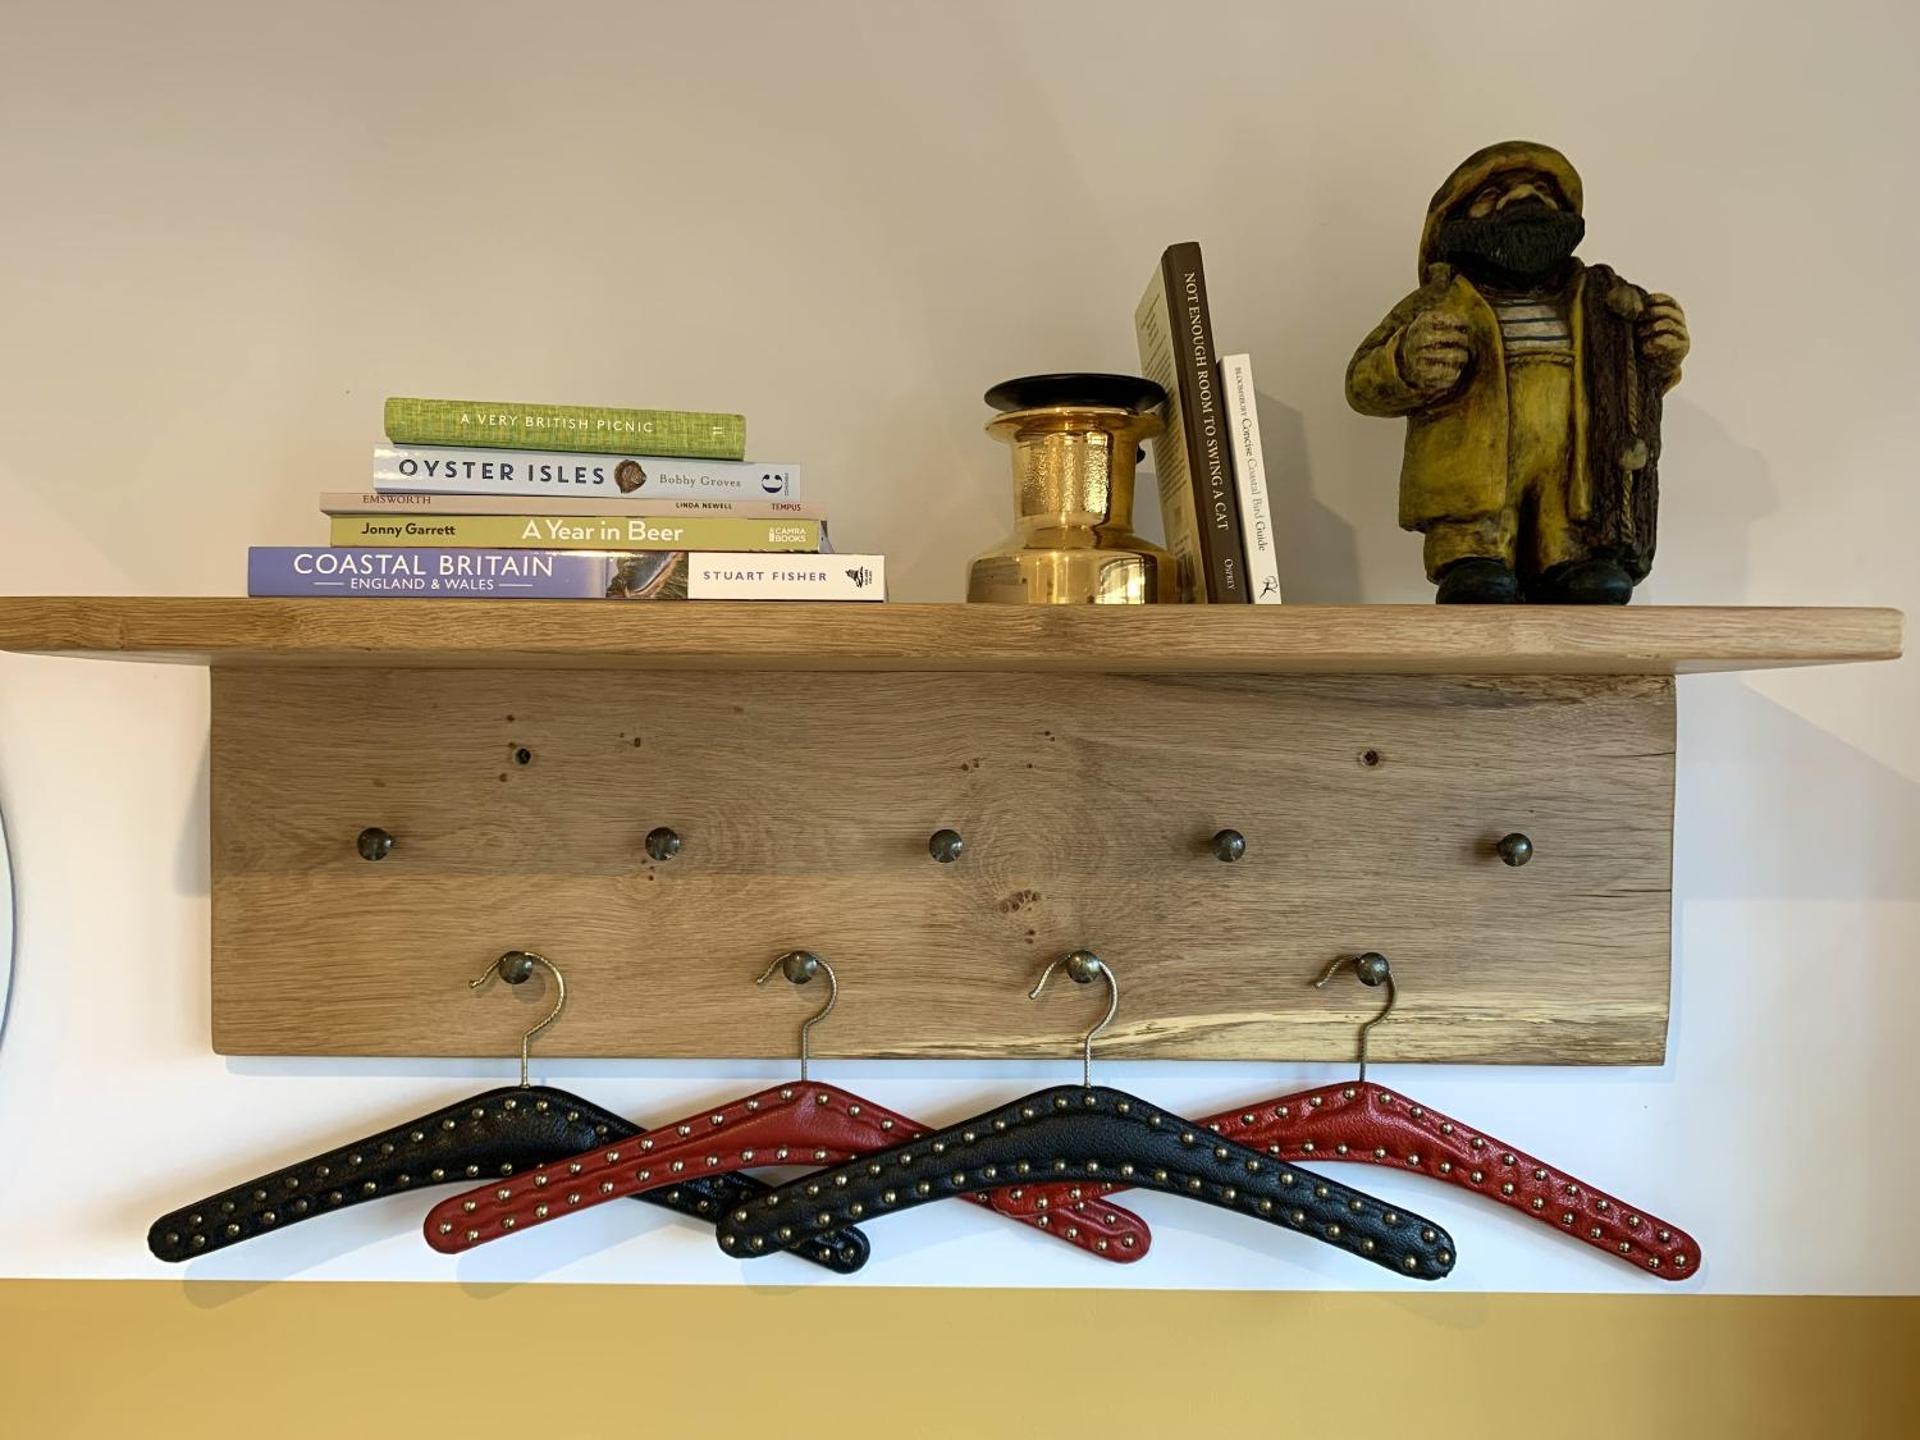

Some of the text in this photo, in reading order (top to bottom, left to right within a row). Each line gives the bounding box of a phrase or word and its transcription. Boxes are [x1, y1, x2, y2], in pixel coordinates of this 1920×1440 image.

[1184, 271, 1229, 531] NOT ENOUGH ROOM TO SWING A CAT
[460, 414, 654, 433] A VERY BRITISH PICNIC
[1242, 418, 1253, 456] Concise
[398, 458, 604, 485] OYSTER ISLES
[1247, 458, 1262, 496] Coastal
[659, 473, 741, 488] Bobby Groves
[362, 494, 431, 505] EMSWORTH
[675, 501, 733, 510] LINDA NEWELL
[771, 503, 801, 511] TEMPUS
[1252, 497, 1264, 520] Bird
[361, 522, 456, 538] Jonny Garrett
[521, 519, 684, 542] A Year in Beer
[775, 527, 807, 535] CAMRA
[775, 534, 807, 543] BOOKS
[1255, 521, 1268, 551] Guide
[293, 552, 553, 577] COASTAL BRITAIN
[350, 577, 494, 591] ENGLAND & WALES
[703, 570, 827, 582] STUART FISHER
